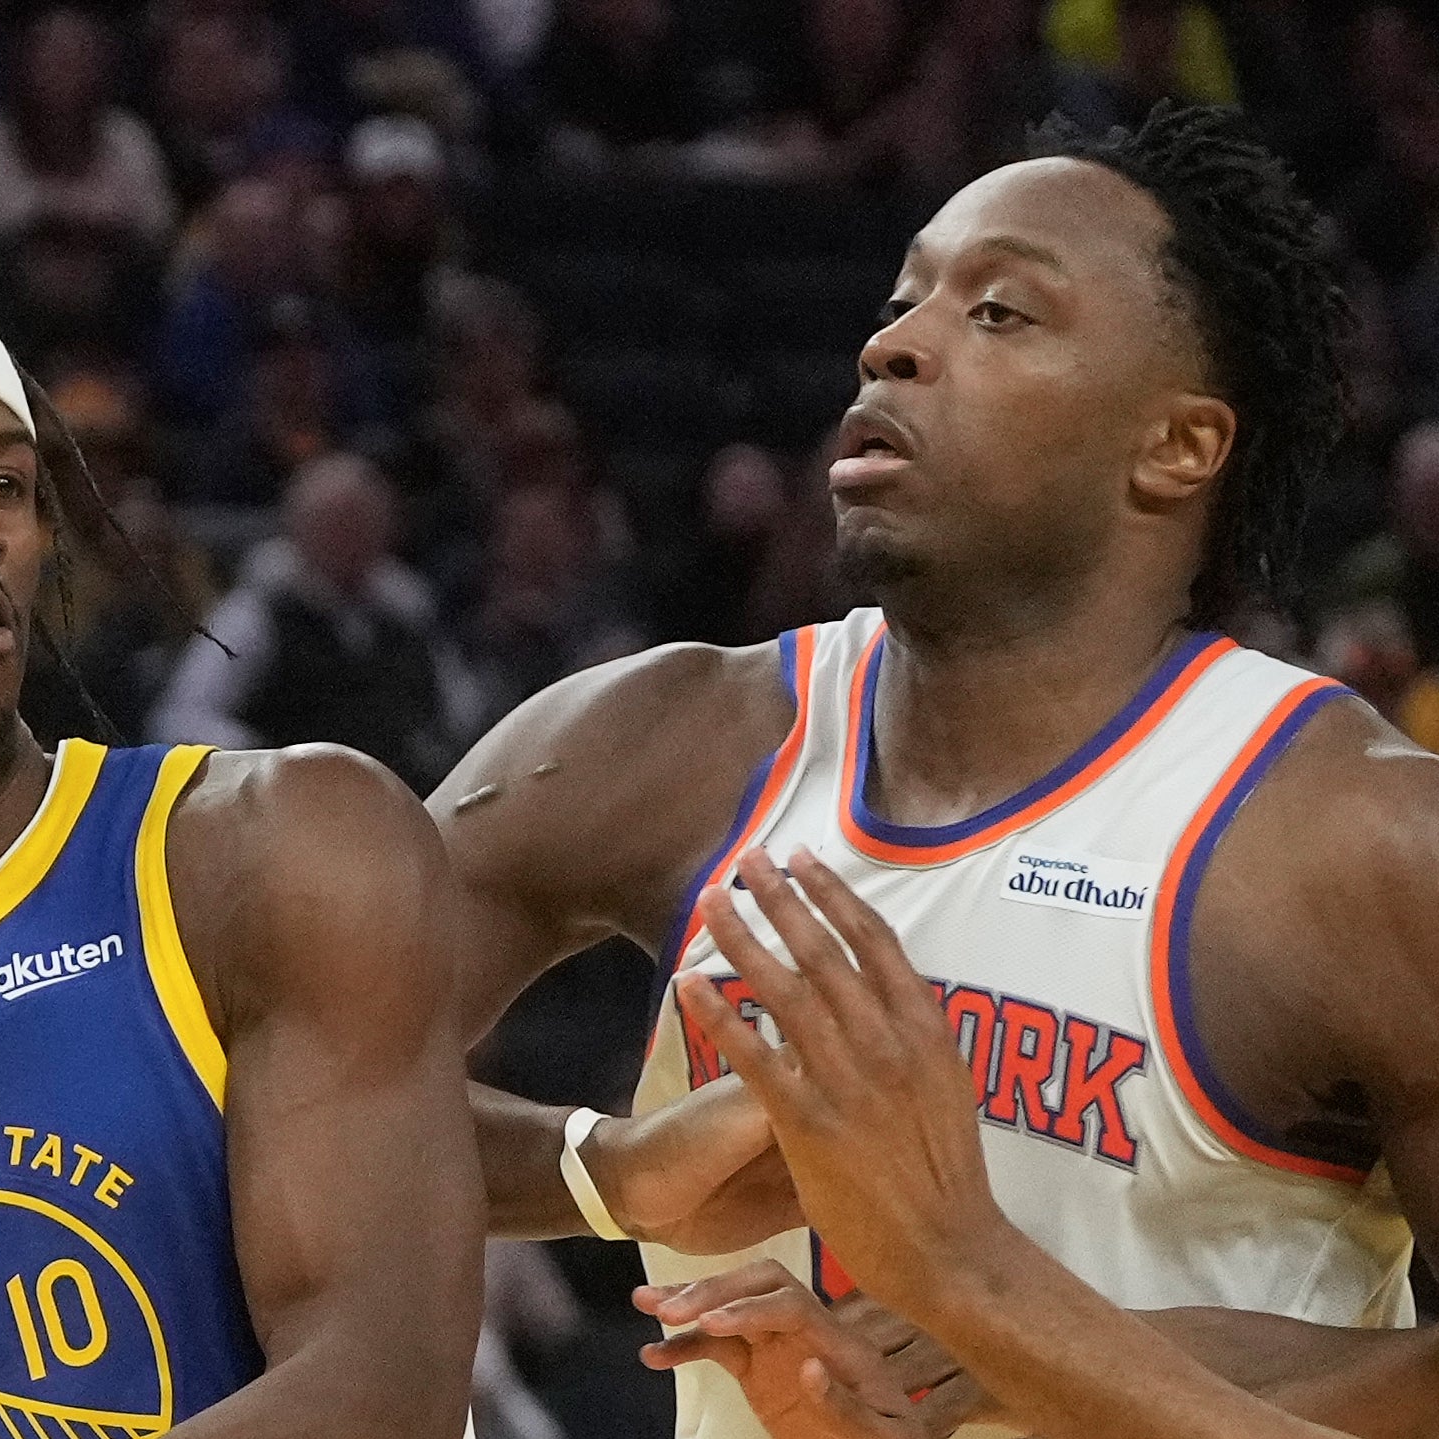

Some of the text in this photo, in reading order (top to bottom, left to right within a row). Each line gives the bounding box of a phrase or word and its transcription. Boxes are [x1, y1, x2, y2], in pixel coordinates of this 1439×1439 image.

[1008, 870, 1149, 910] abu dhabi
[1018, 854, 1089, 874] experience
[925, 976, 1151, 1174] ORK
[6, 1258, 108, 1382] 10
